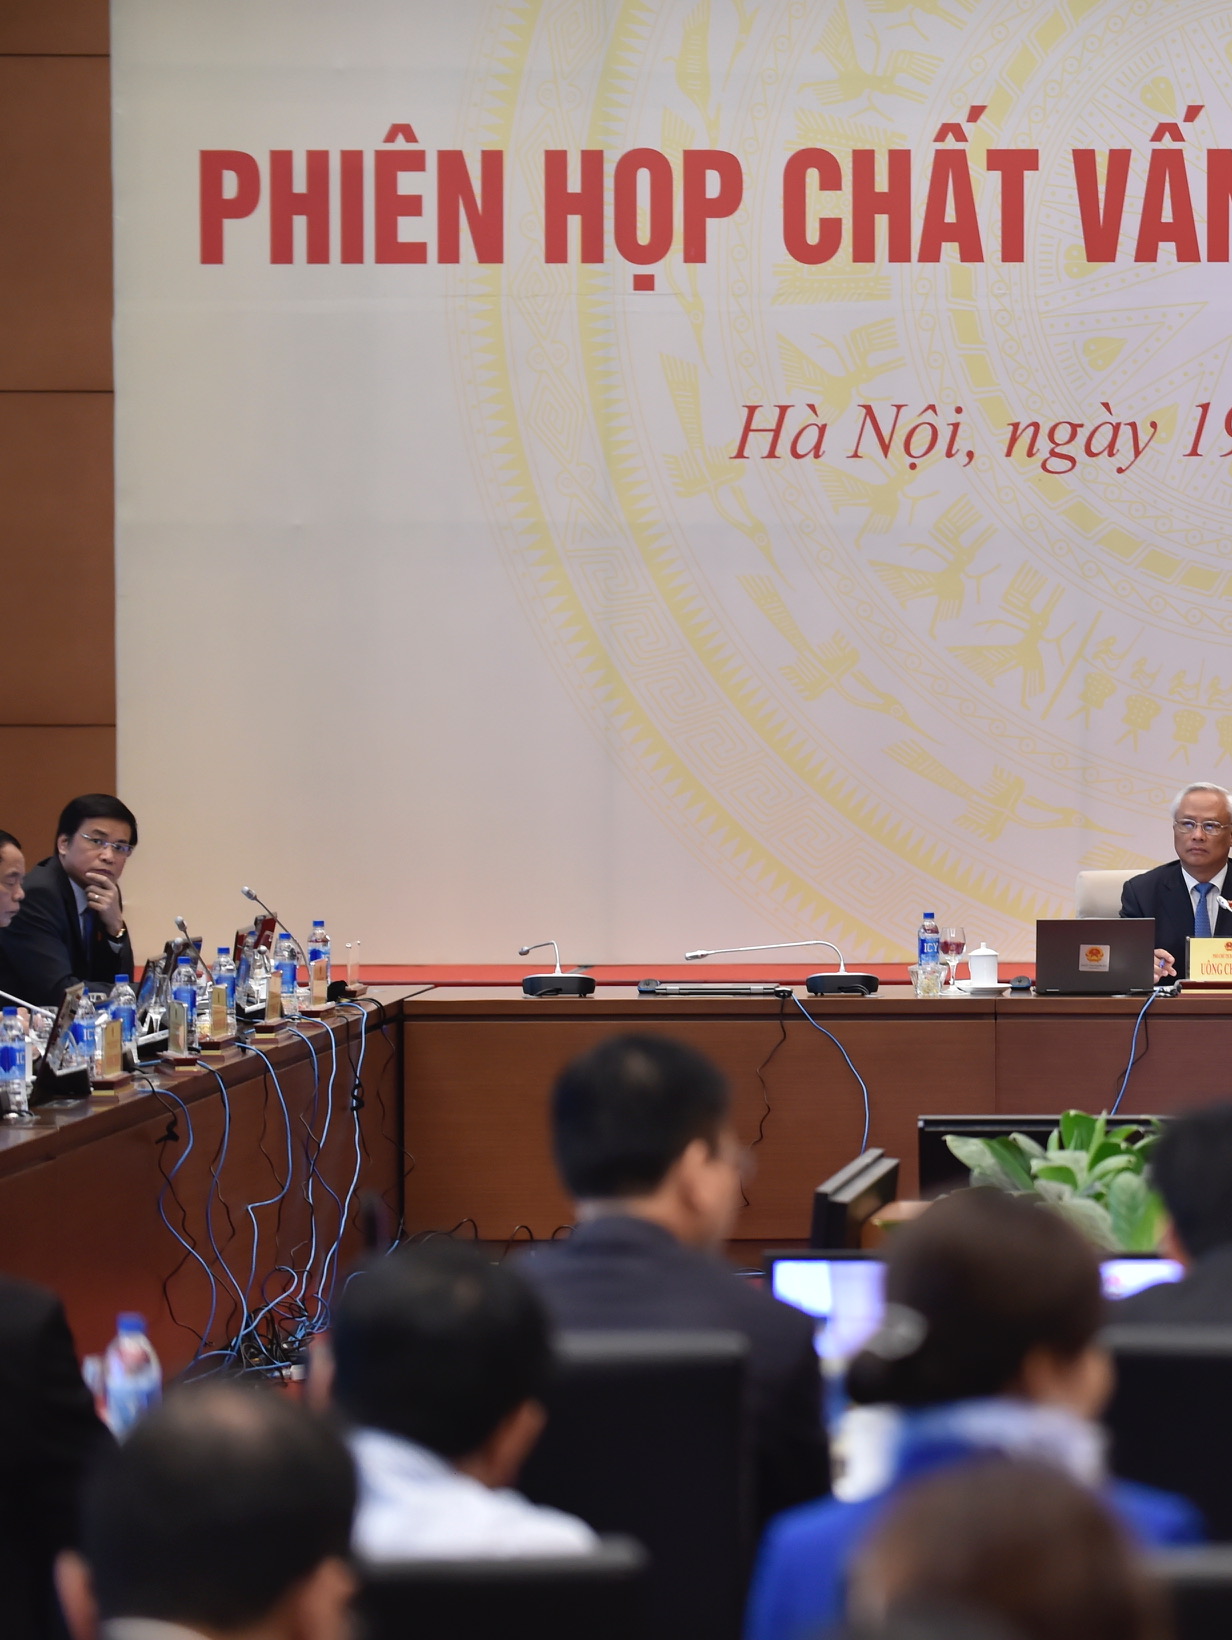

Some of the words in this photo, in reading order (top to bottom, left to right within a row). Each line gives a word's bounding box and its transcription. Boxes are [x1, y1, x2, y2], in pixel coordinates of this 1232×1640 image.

[200, 123, 504, 265] PHIÊN
[544, 147, 744, 292] HỌP
[783, 105, 1040, 265] CHẤT
[733, 403, 828, 460] Hà
[850, 404, 975, 471] Nội,
[1005, 401, 1158, 475] ngày
[924, 942, 939, 953] ICY
